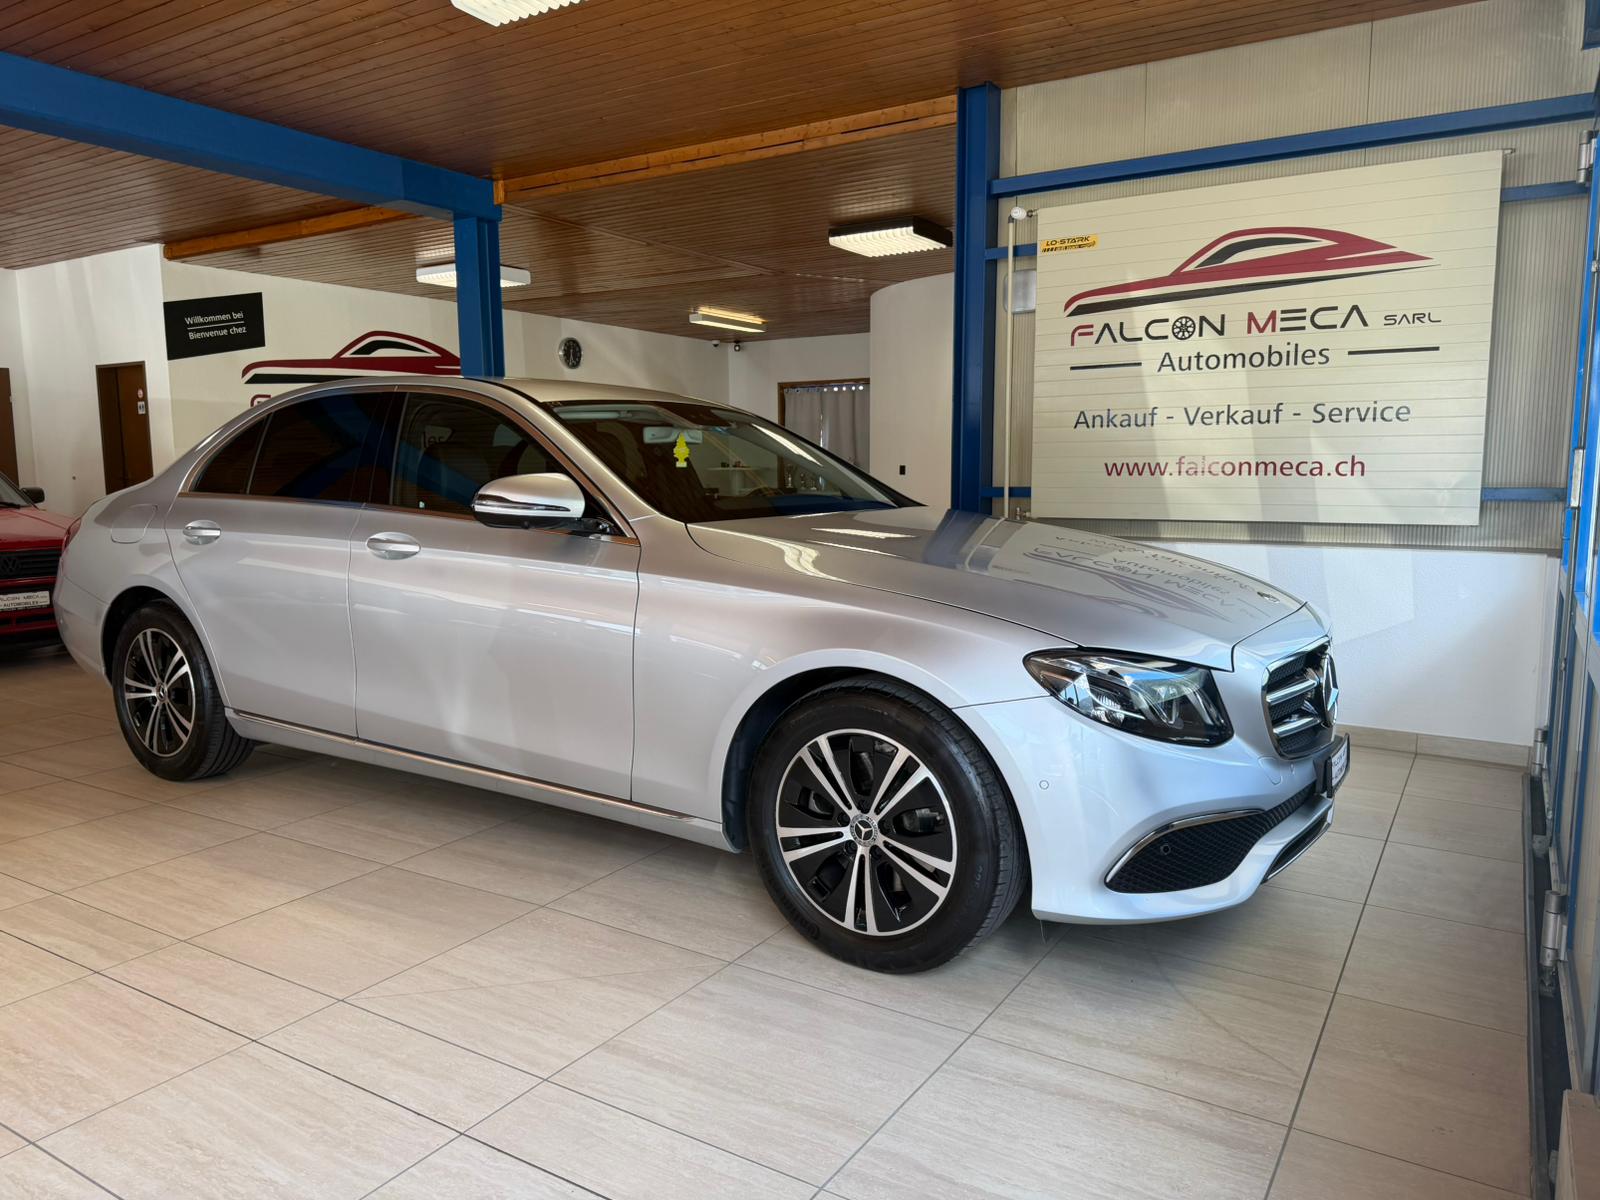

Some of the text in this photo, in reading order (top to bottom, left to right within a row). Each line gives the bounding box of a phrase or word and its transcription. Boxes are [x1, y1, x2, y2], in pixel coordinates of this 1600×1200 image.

[184, 311, 244, 324] Willkommen bei
[1070, 304, 1442, 347] FALCON MECA SARL
[188, 326, 247, 339] Bienvenue chez
[1157, 342, 1330, 373] Automobiles
[1073, 406, 1159, 430] Ankauf
[1183, 402, 1284, 427] Verkauf
[1311, 400, 1412, 424] Service
[1103, 454, 1366, 477] www.falconmeca.ch
